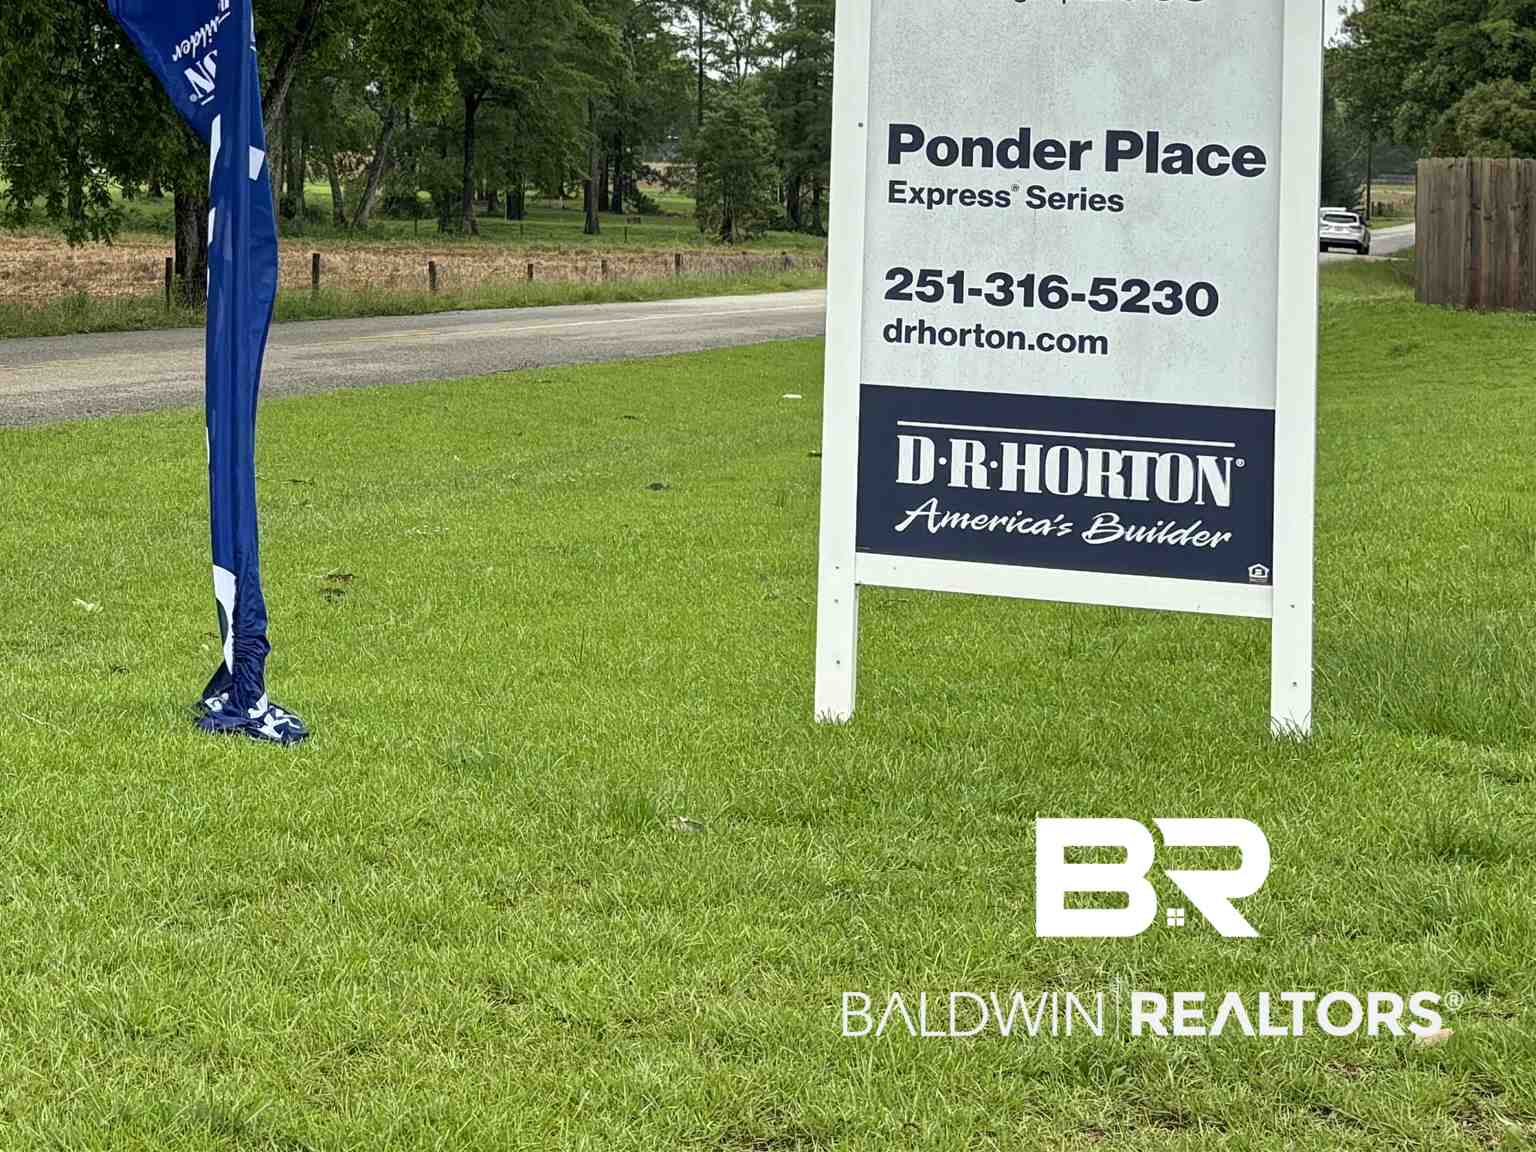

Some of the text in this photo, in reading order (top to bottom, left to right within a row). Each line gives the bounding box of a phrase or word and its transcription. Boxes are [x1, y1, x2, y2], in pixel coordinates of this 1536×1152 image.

[887, 123, 1267, 178] Ponder Place
[1025, 184, 1125, 213] Series
[884, 266, 1219, 317] 251-316-5230
[882, 317, 1109, 355] drhorton.com
[894, 496, 1233, 549] America's Builder
